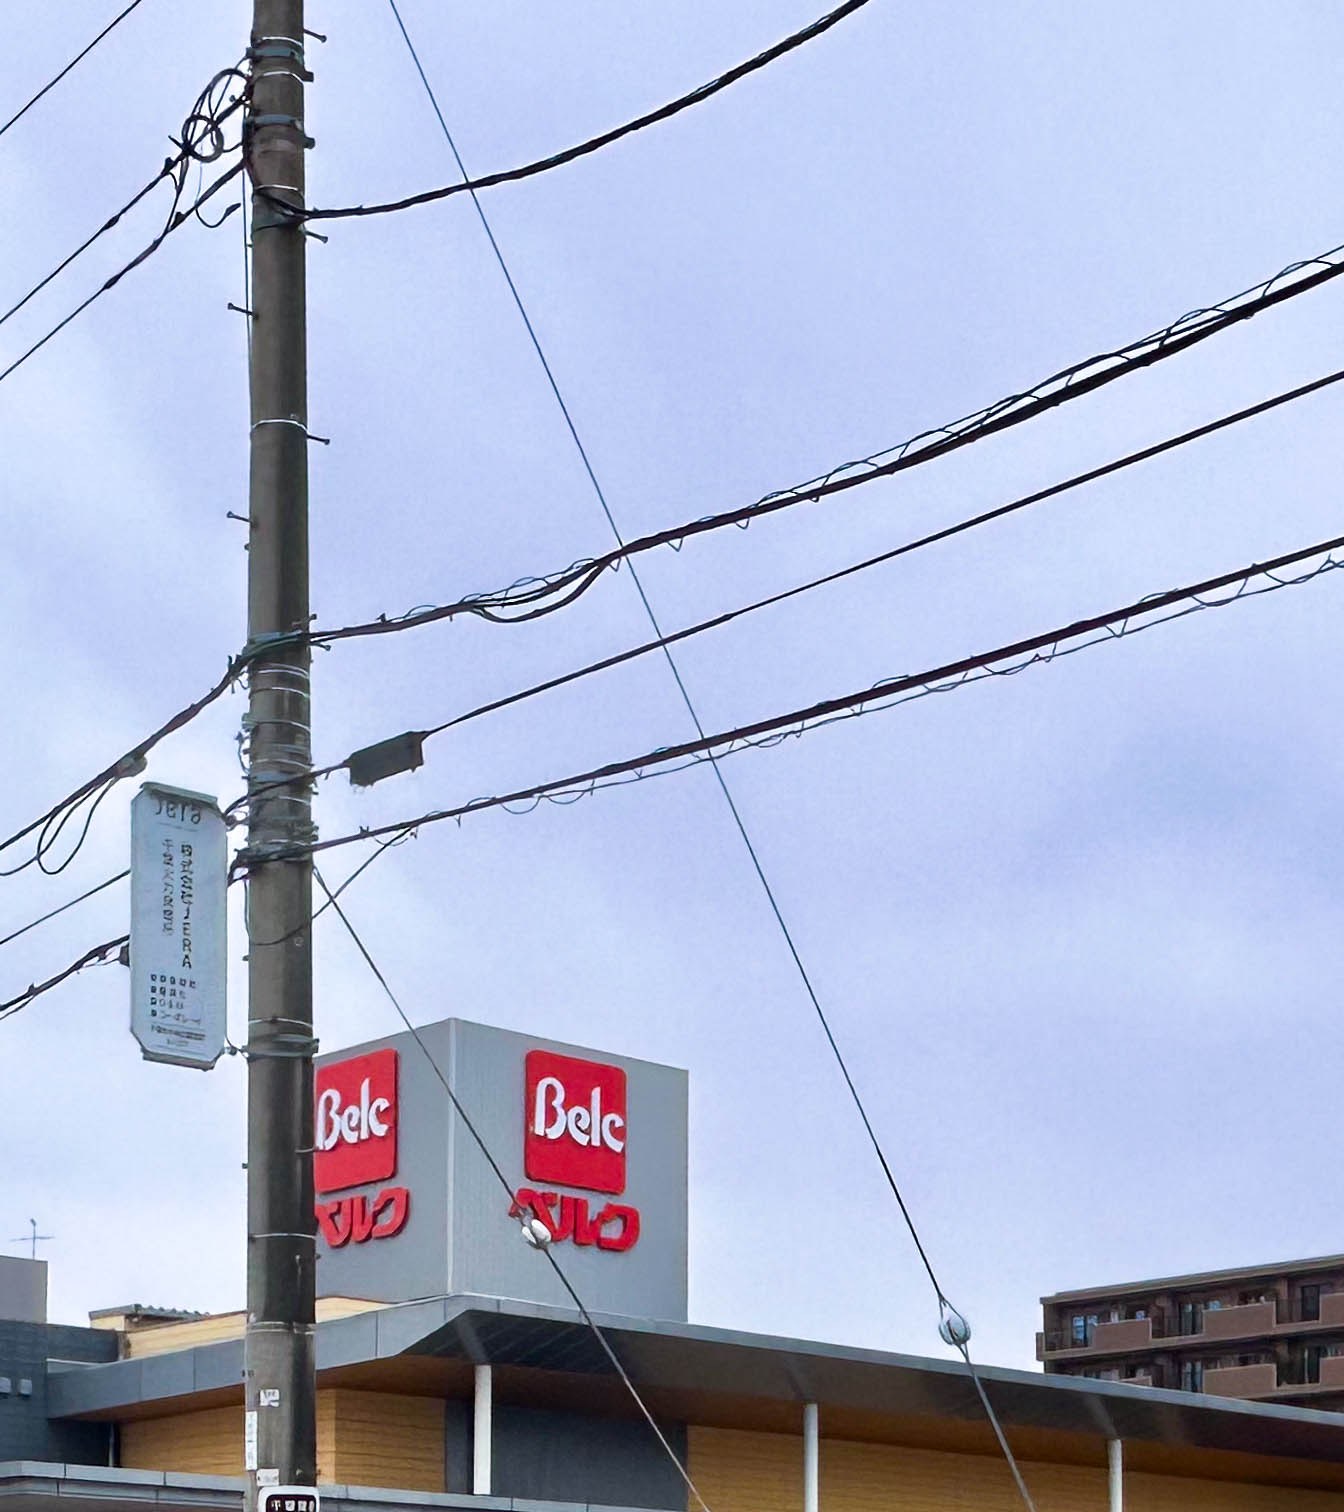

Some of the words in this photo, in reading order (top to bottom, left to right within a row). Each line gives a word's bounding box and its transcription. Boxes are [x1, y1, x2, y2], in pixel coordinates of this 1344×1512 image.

[316, 1078, 391, 1151] Belc
[535, 1076, 625, 1152] Belc
[508, 1188, 641, 1252] ベルク
